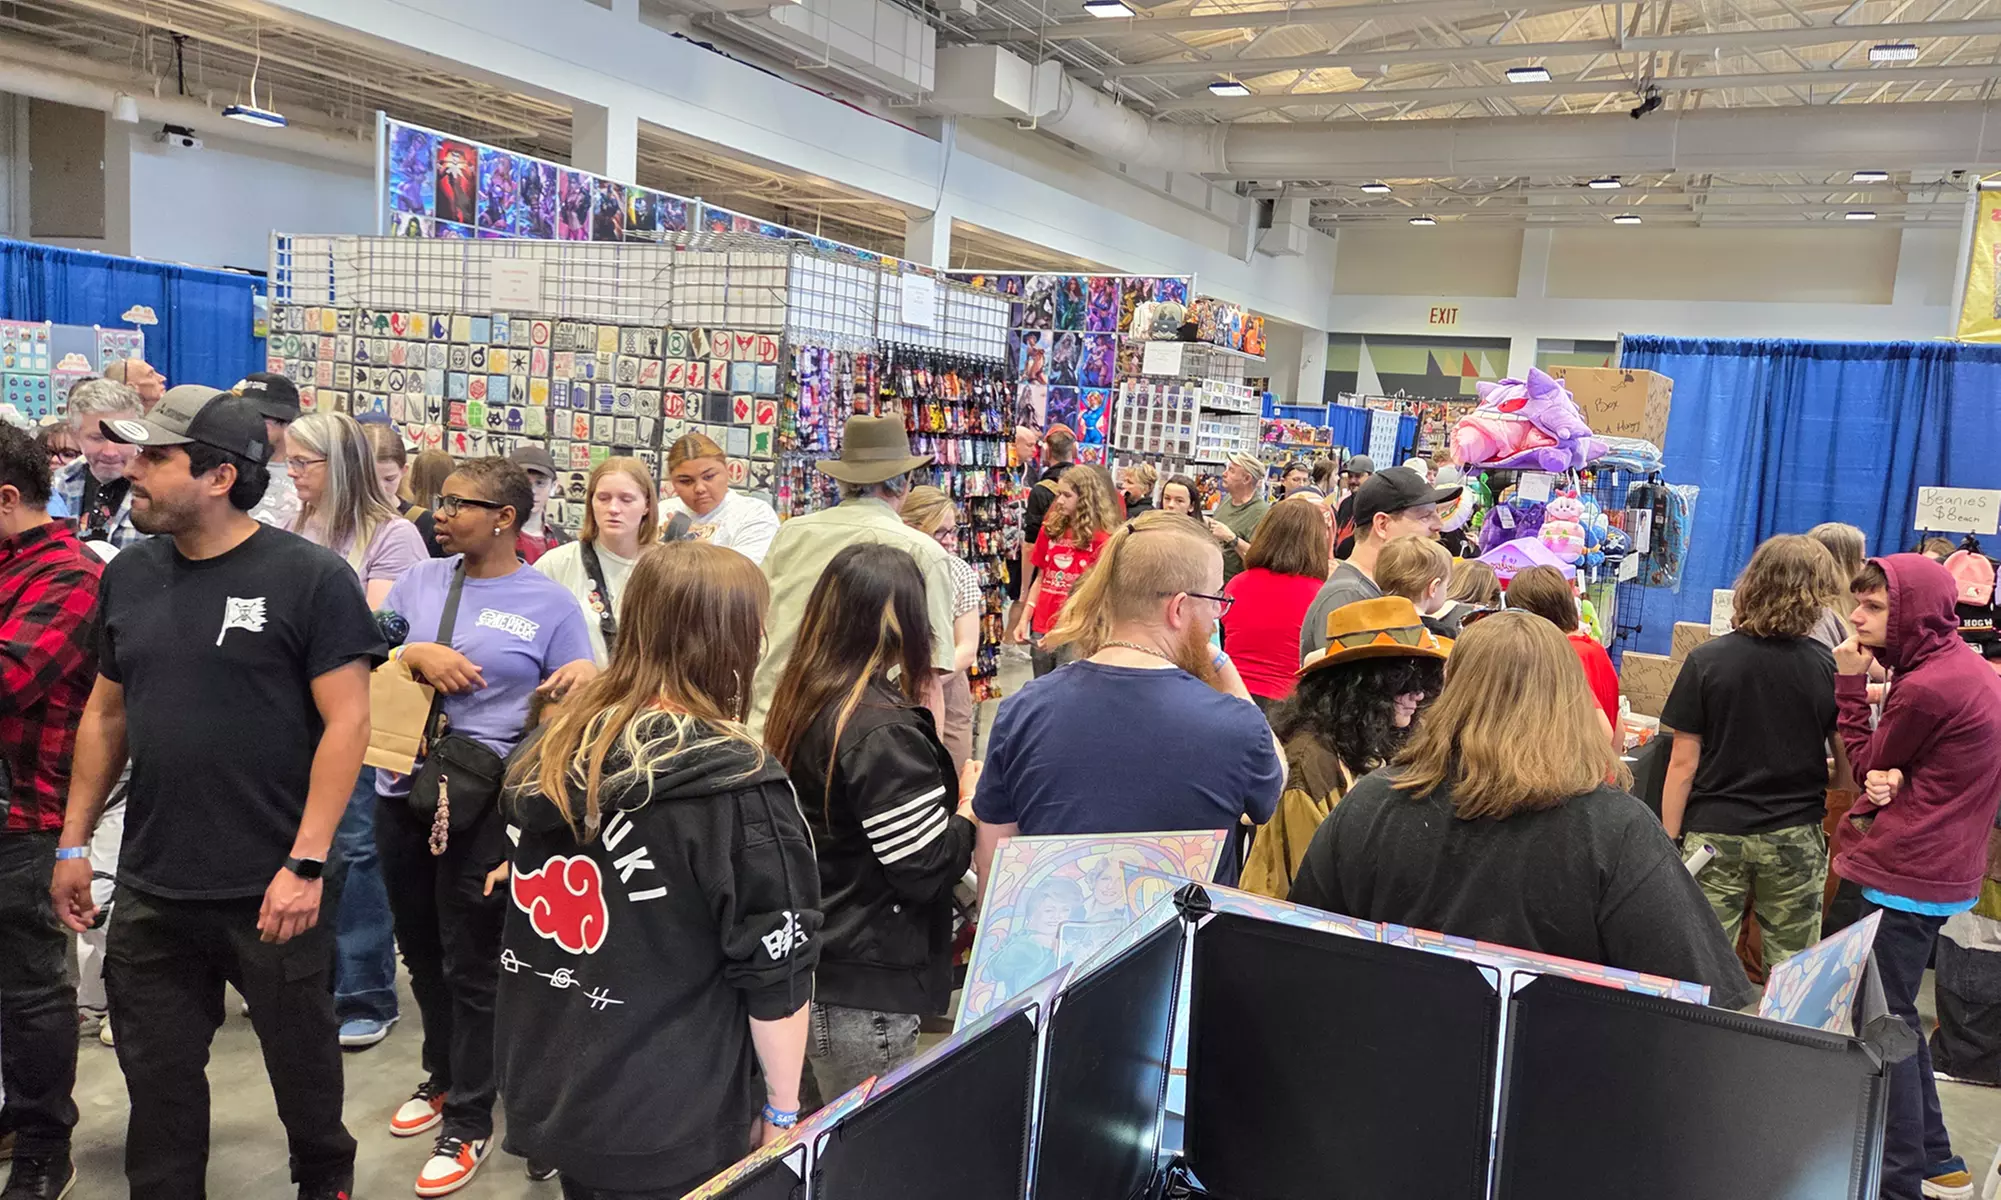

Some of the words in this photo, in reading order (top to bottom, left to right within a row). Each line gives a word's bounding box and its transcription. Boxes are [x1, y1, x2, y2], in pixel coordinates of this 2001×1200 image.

[1430, 307, 1459, 324] EXIT
[1595, 398, 1619, 412] Box
[1919, 488, 1987, 508] Beanies
